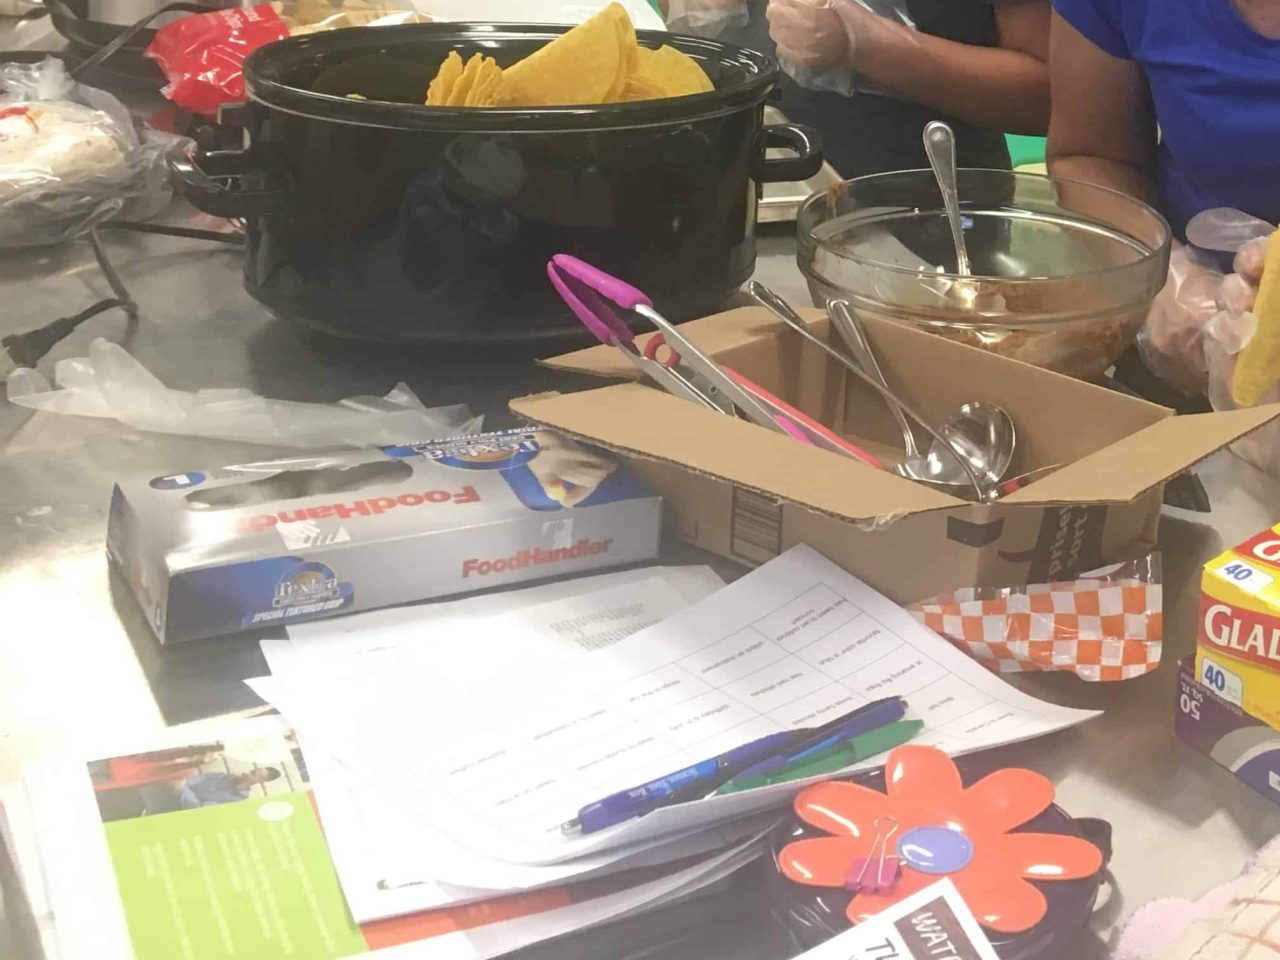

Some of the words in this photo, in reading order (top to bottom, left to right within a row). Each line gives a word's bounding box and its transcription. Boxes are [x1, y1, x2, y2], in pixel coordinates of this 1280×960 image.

[461, 537, 614, 578] FoodHandler
[1223, 564, 1253, 581] 40
[1204, 665, 1226, 692] 40
